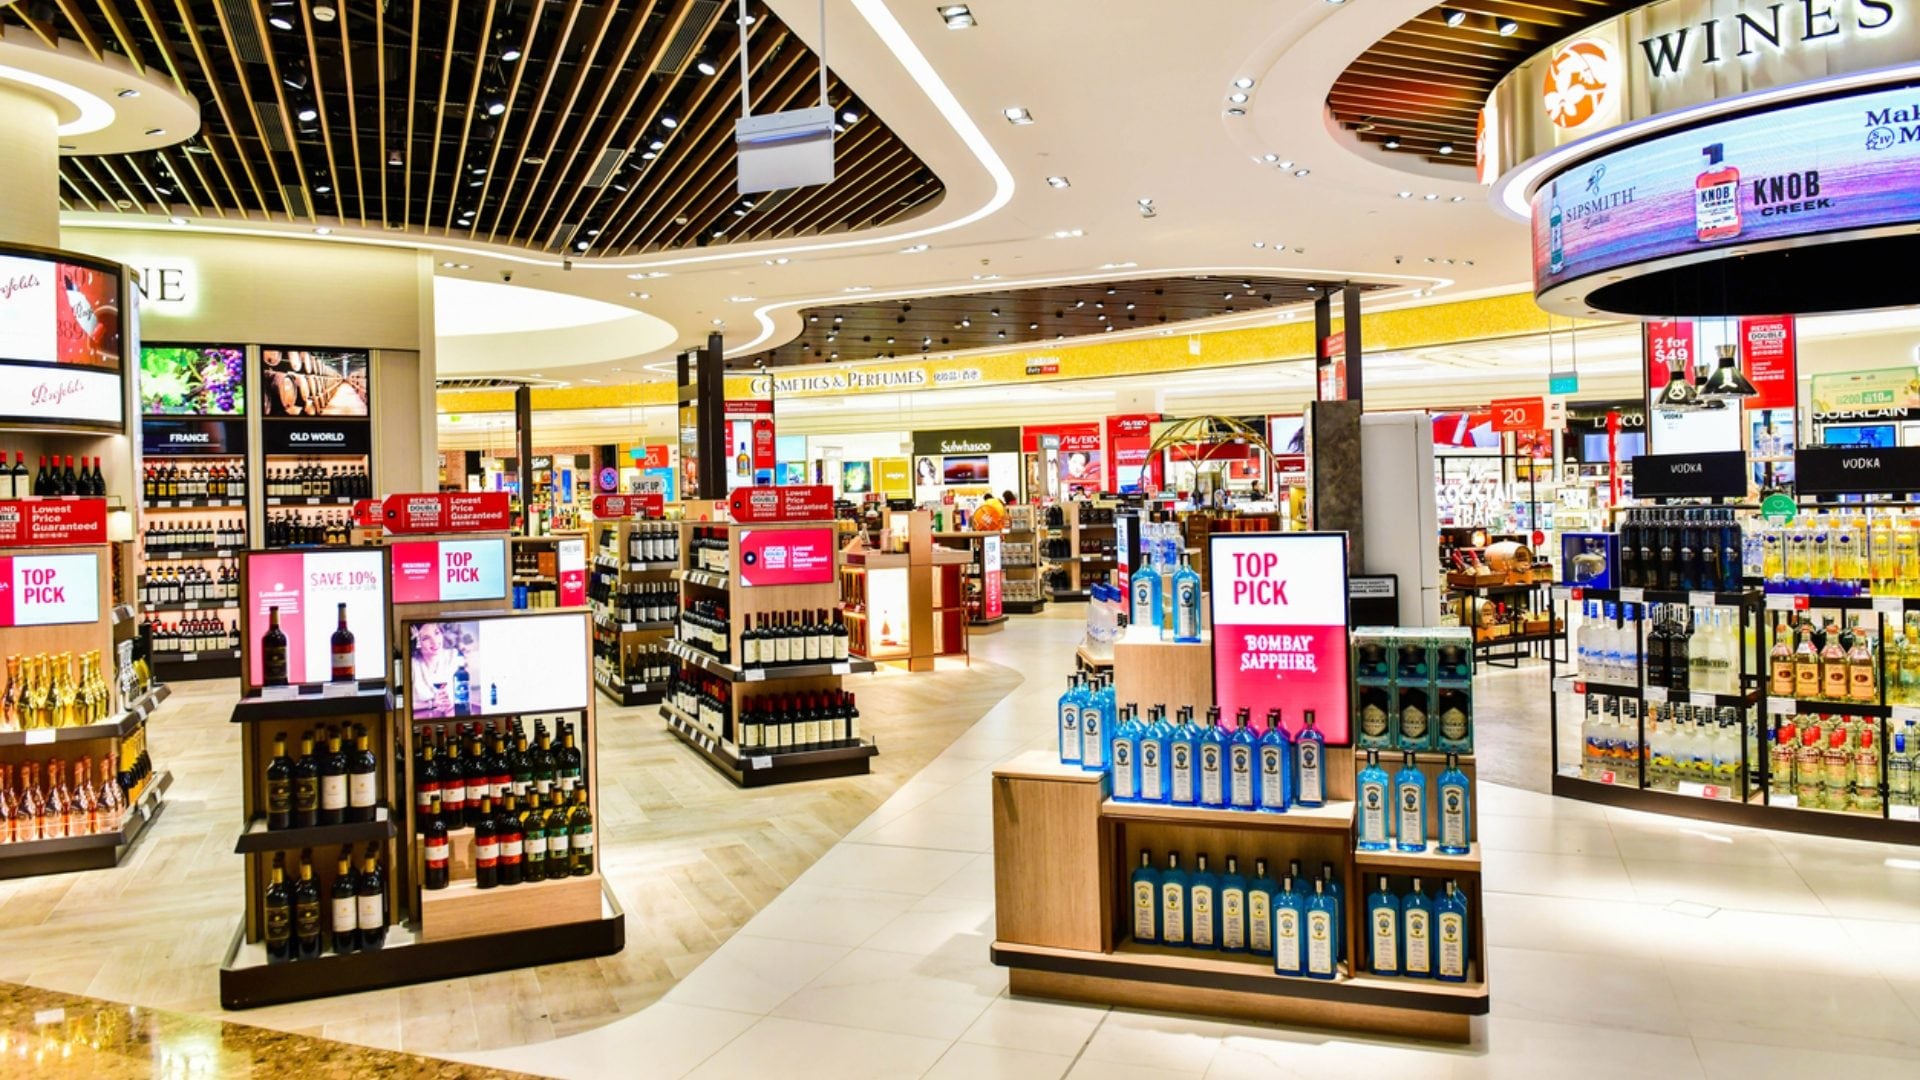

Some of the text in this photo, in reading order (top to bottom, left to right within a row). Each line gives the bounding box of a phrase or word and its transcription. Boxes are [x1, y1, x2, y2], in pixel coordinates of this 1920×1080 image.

[1639, 0, 1894, 78] WINES
[1700, 186, 1730, 203] KNOB
[1753, 170, 1820, 206] KNOB
[1565, 187, 1635, 223] SIPSMITH
[1654, 336, 1688, 350] 2 for
[1751, 331, 1784, 340] DOUBLE
[1654, 349, 1688, 363] $49
[751, 371, 924, 394] COSMETICS & PERFUMES
[169, 433, 209, 443] FRANCE
[289, 432, 345, 442] OLD WORLD
[940, 440, 992, 453] Sulwhasoo
[1670, 462, 1703, 474] VODKA
[1842, 457, 1881, 469] VODKA
[32, 505, 72, 514] Lowest
[450, 504, 474, 512] Price
[451, 511, 502, 520] Guaranteed
[32, 513, 62, 523] Price
[32, 521, 98, 532] Guaranteed
[445, 551, 473, 567] TOP
[1231, 552, 1279, 578] TOP
[22, 568, 56, 586] TOP
[310, 571, 377, 587] SAVE 10%
[446, 567, 480, 583] PICK
[24, 586, 65, 605] PICK
[1233, 580, 1289, 606] PICK
[1243, 634, 1315, 652] BOMBAY
[1239, 652, 1319, 674] SAPPHIRE
